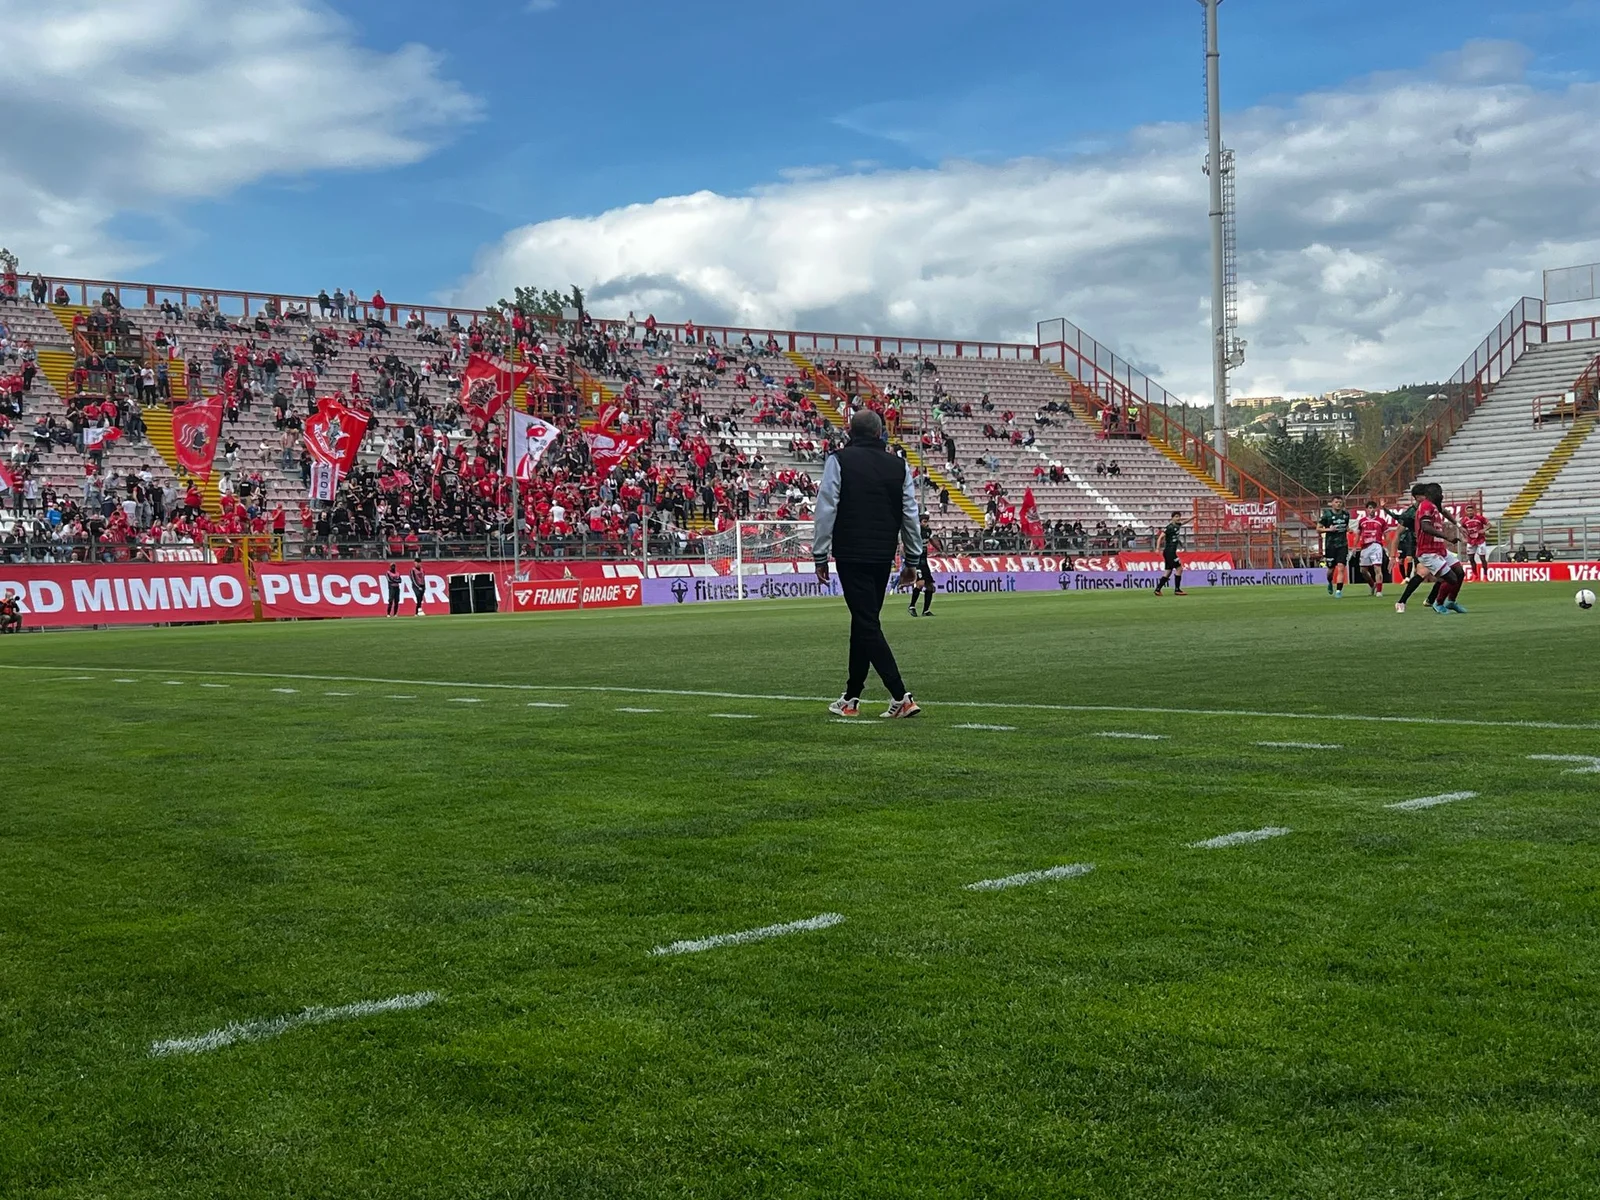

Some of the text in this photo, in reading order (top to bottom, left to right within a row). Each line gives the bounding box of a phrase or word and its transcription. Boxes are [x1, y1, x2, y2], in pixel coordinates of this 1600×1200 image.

[1221, 571, 1314, 587] fitness-discount.it
[71, 575, 243, 612] MIMMO
[261, 573, 450, 606] PUCCIAR
[533, 585, 620, 606] FRANKIE GARAGE
